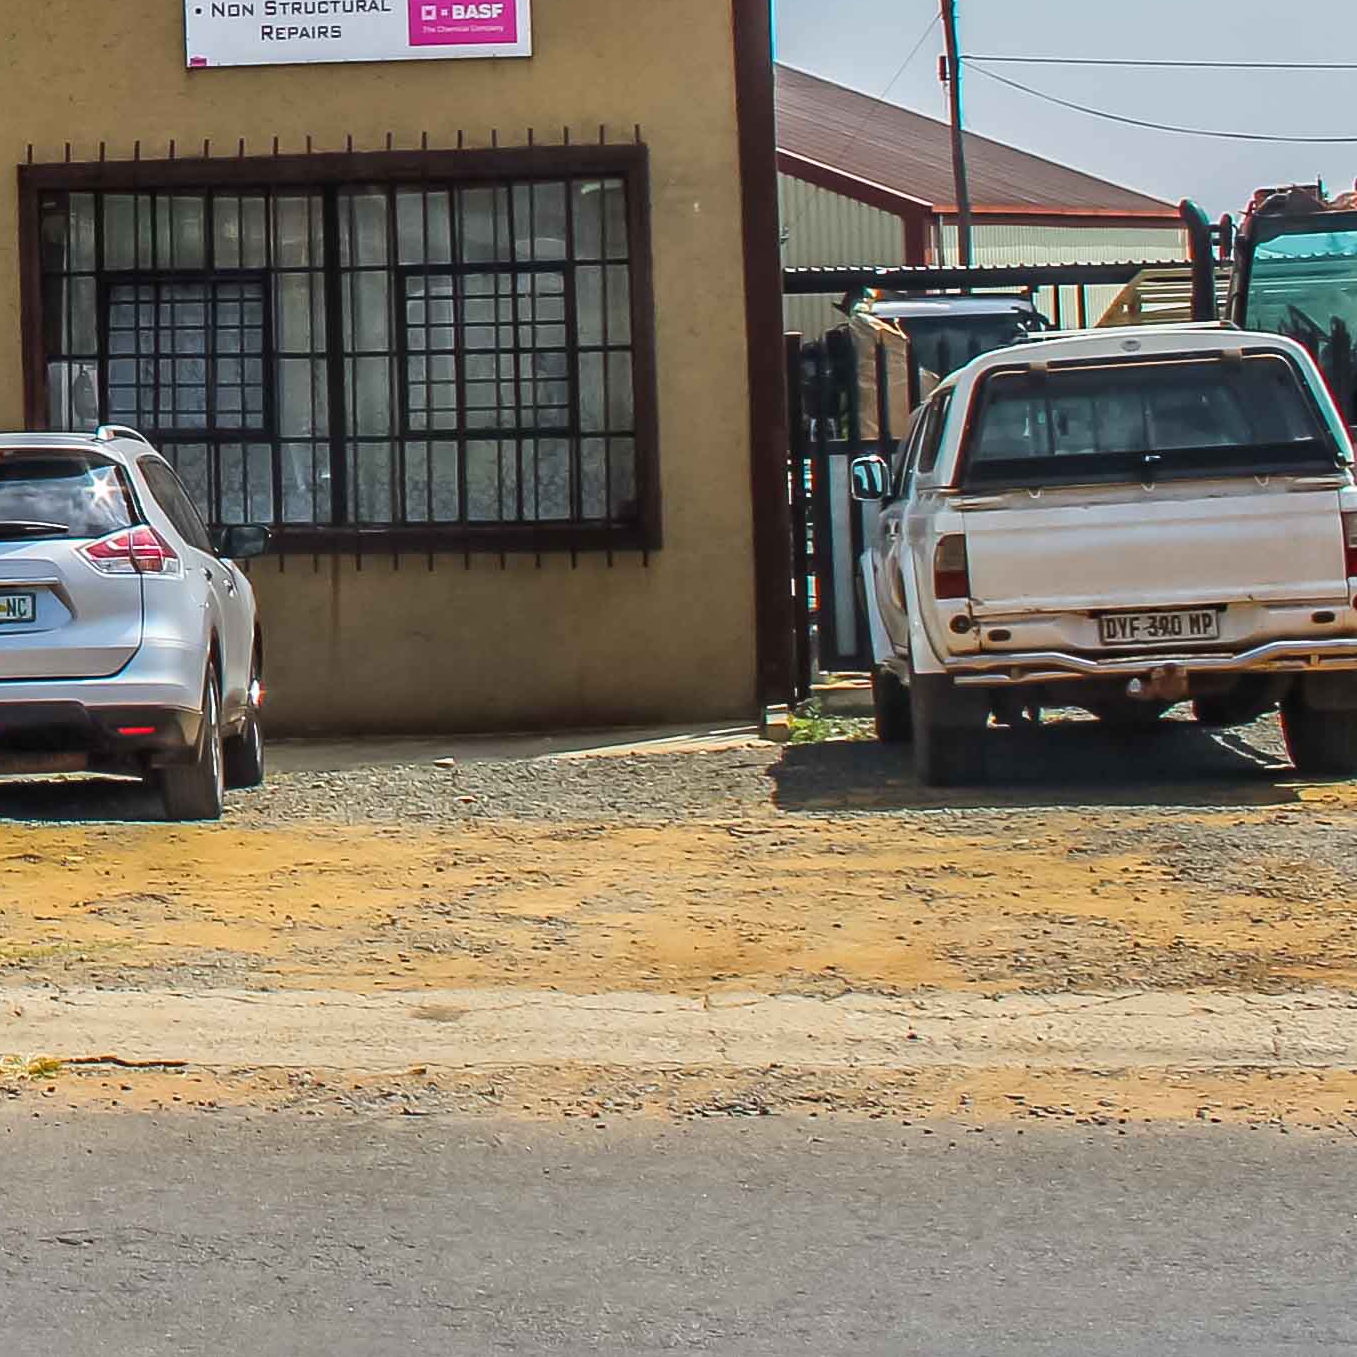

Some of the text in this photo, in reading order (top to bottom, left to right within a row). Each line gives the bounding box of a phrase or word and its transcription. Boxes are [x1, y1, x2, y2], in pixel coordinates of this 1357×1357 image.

[211, 0, 392, 18] NON STRUCTURAL
[452, 3, 504, 20] BASF
[261, 25, 342, 41] REPAIRS
[6, 597, 27, 617] NC
[1107, 617, 1140, 639] DYF
[1189, 612, 1213, 635] MP
